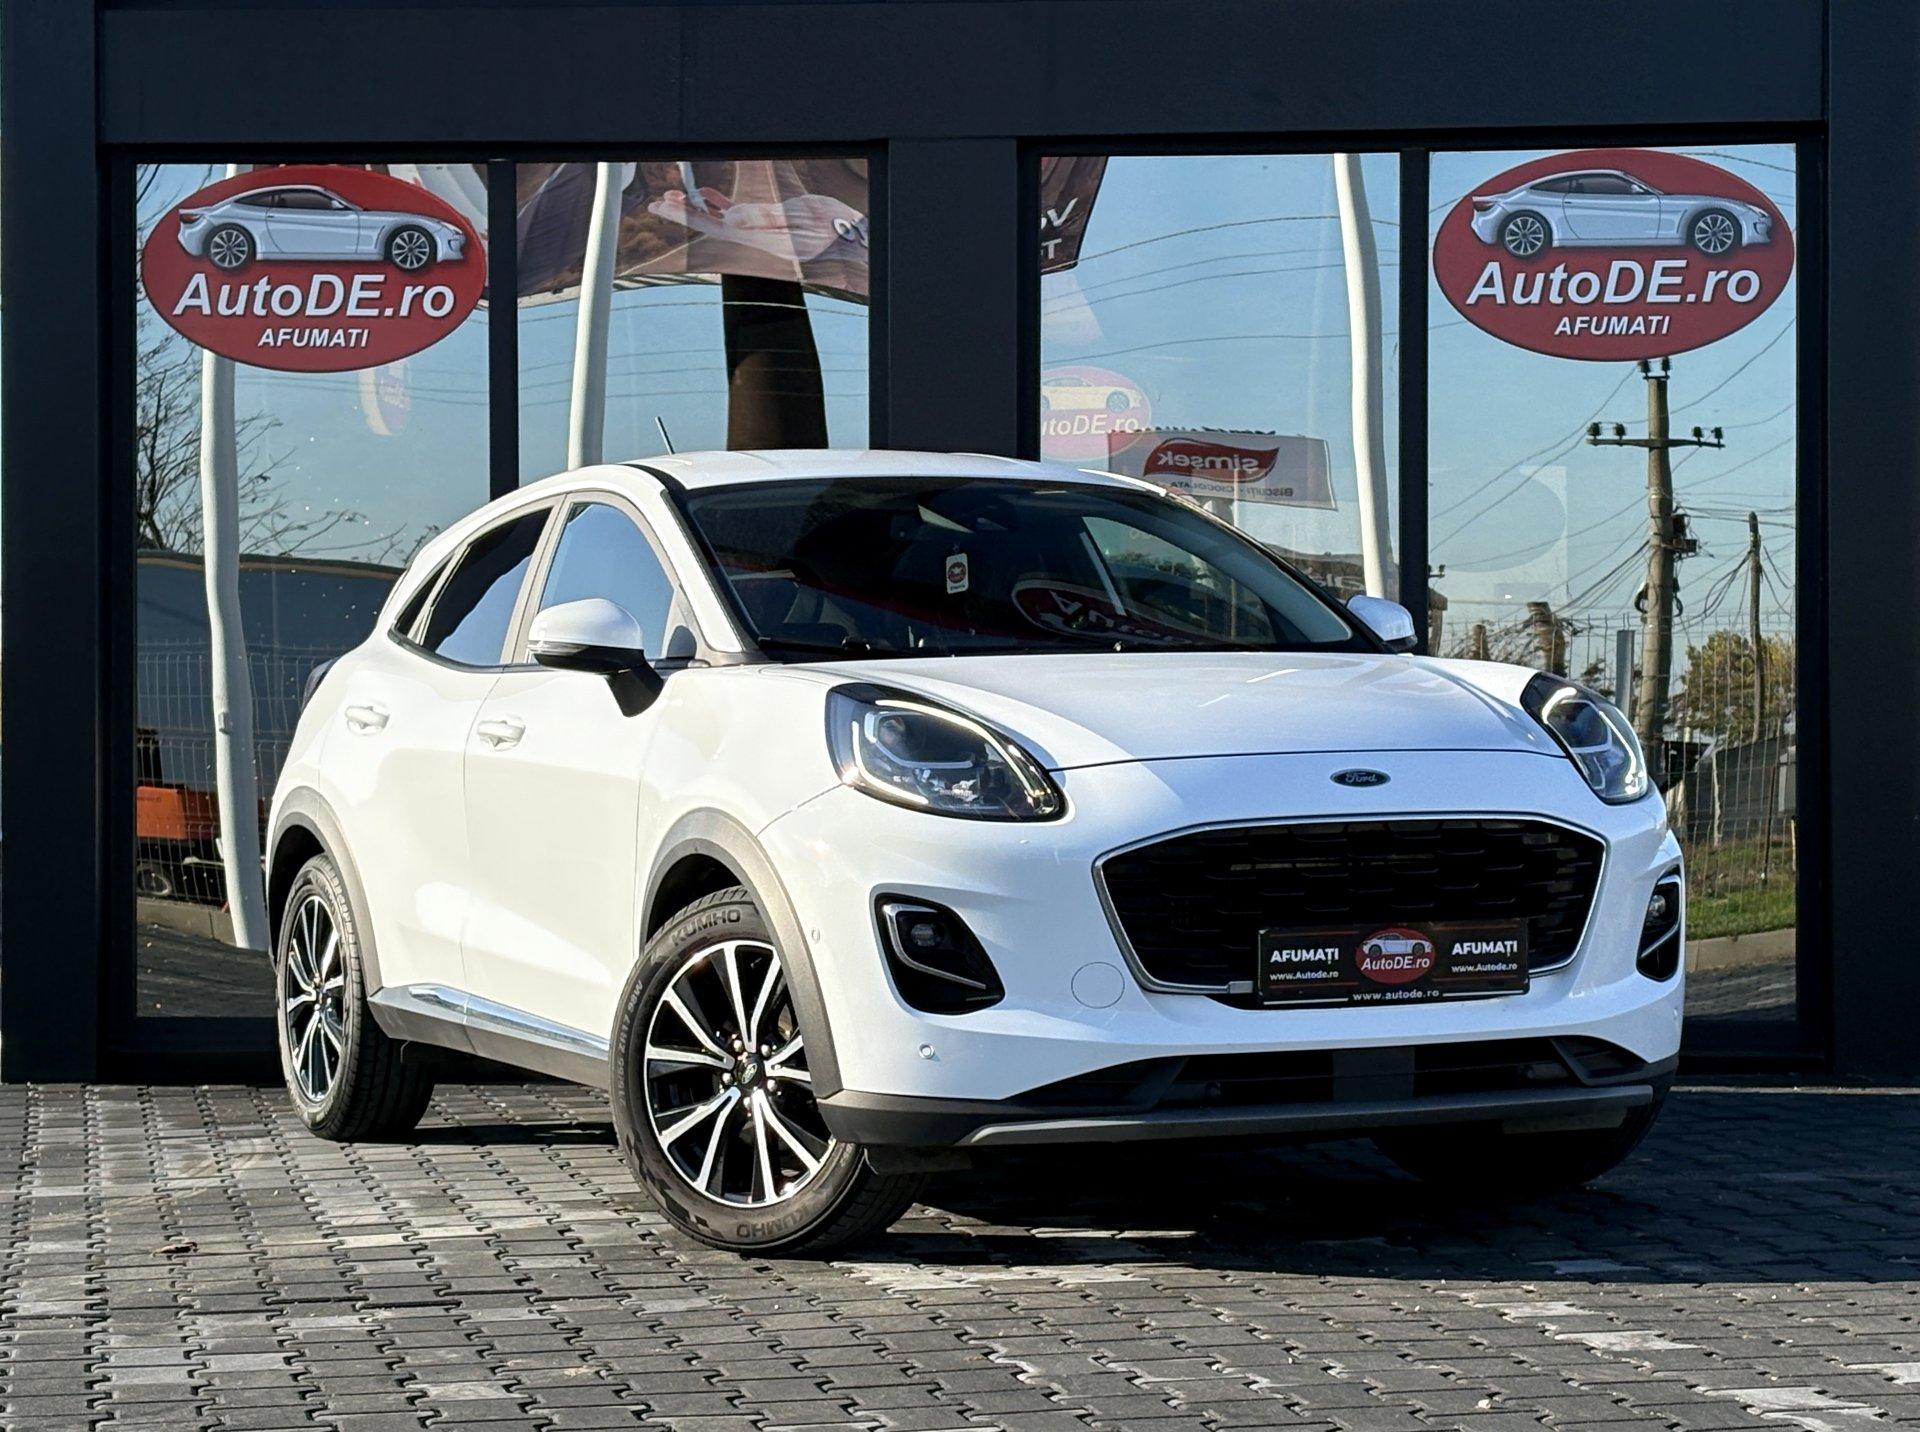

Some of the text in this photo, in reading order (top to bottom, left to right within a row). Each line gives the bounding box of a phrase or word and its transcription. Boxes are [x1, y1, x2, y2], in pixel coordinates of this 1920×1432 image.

[1466, 259, 1761, 305] AutoDE.ro
[172, 273, 455, 317] AutoDE.ro
[1554, 315, 1671, 336] AFUMATI
[257, 328, 370, 348] AFUMATI
[1345, 770, 1378, 784] Ford
[671, 909, 741, 946] KUMHO
[1361, 955, 1430, 971] AutoDE.ro
[1451, 962, 1518, 973] www.Autode.ro
[1269, 970, 1339, 981] www.Autode.ro
[1353, 988, 1440, 1001] www.autode.ro
